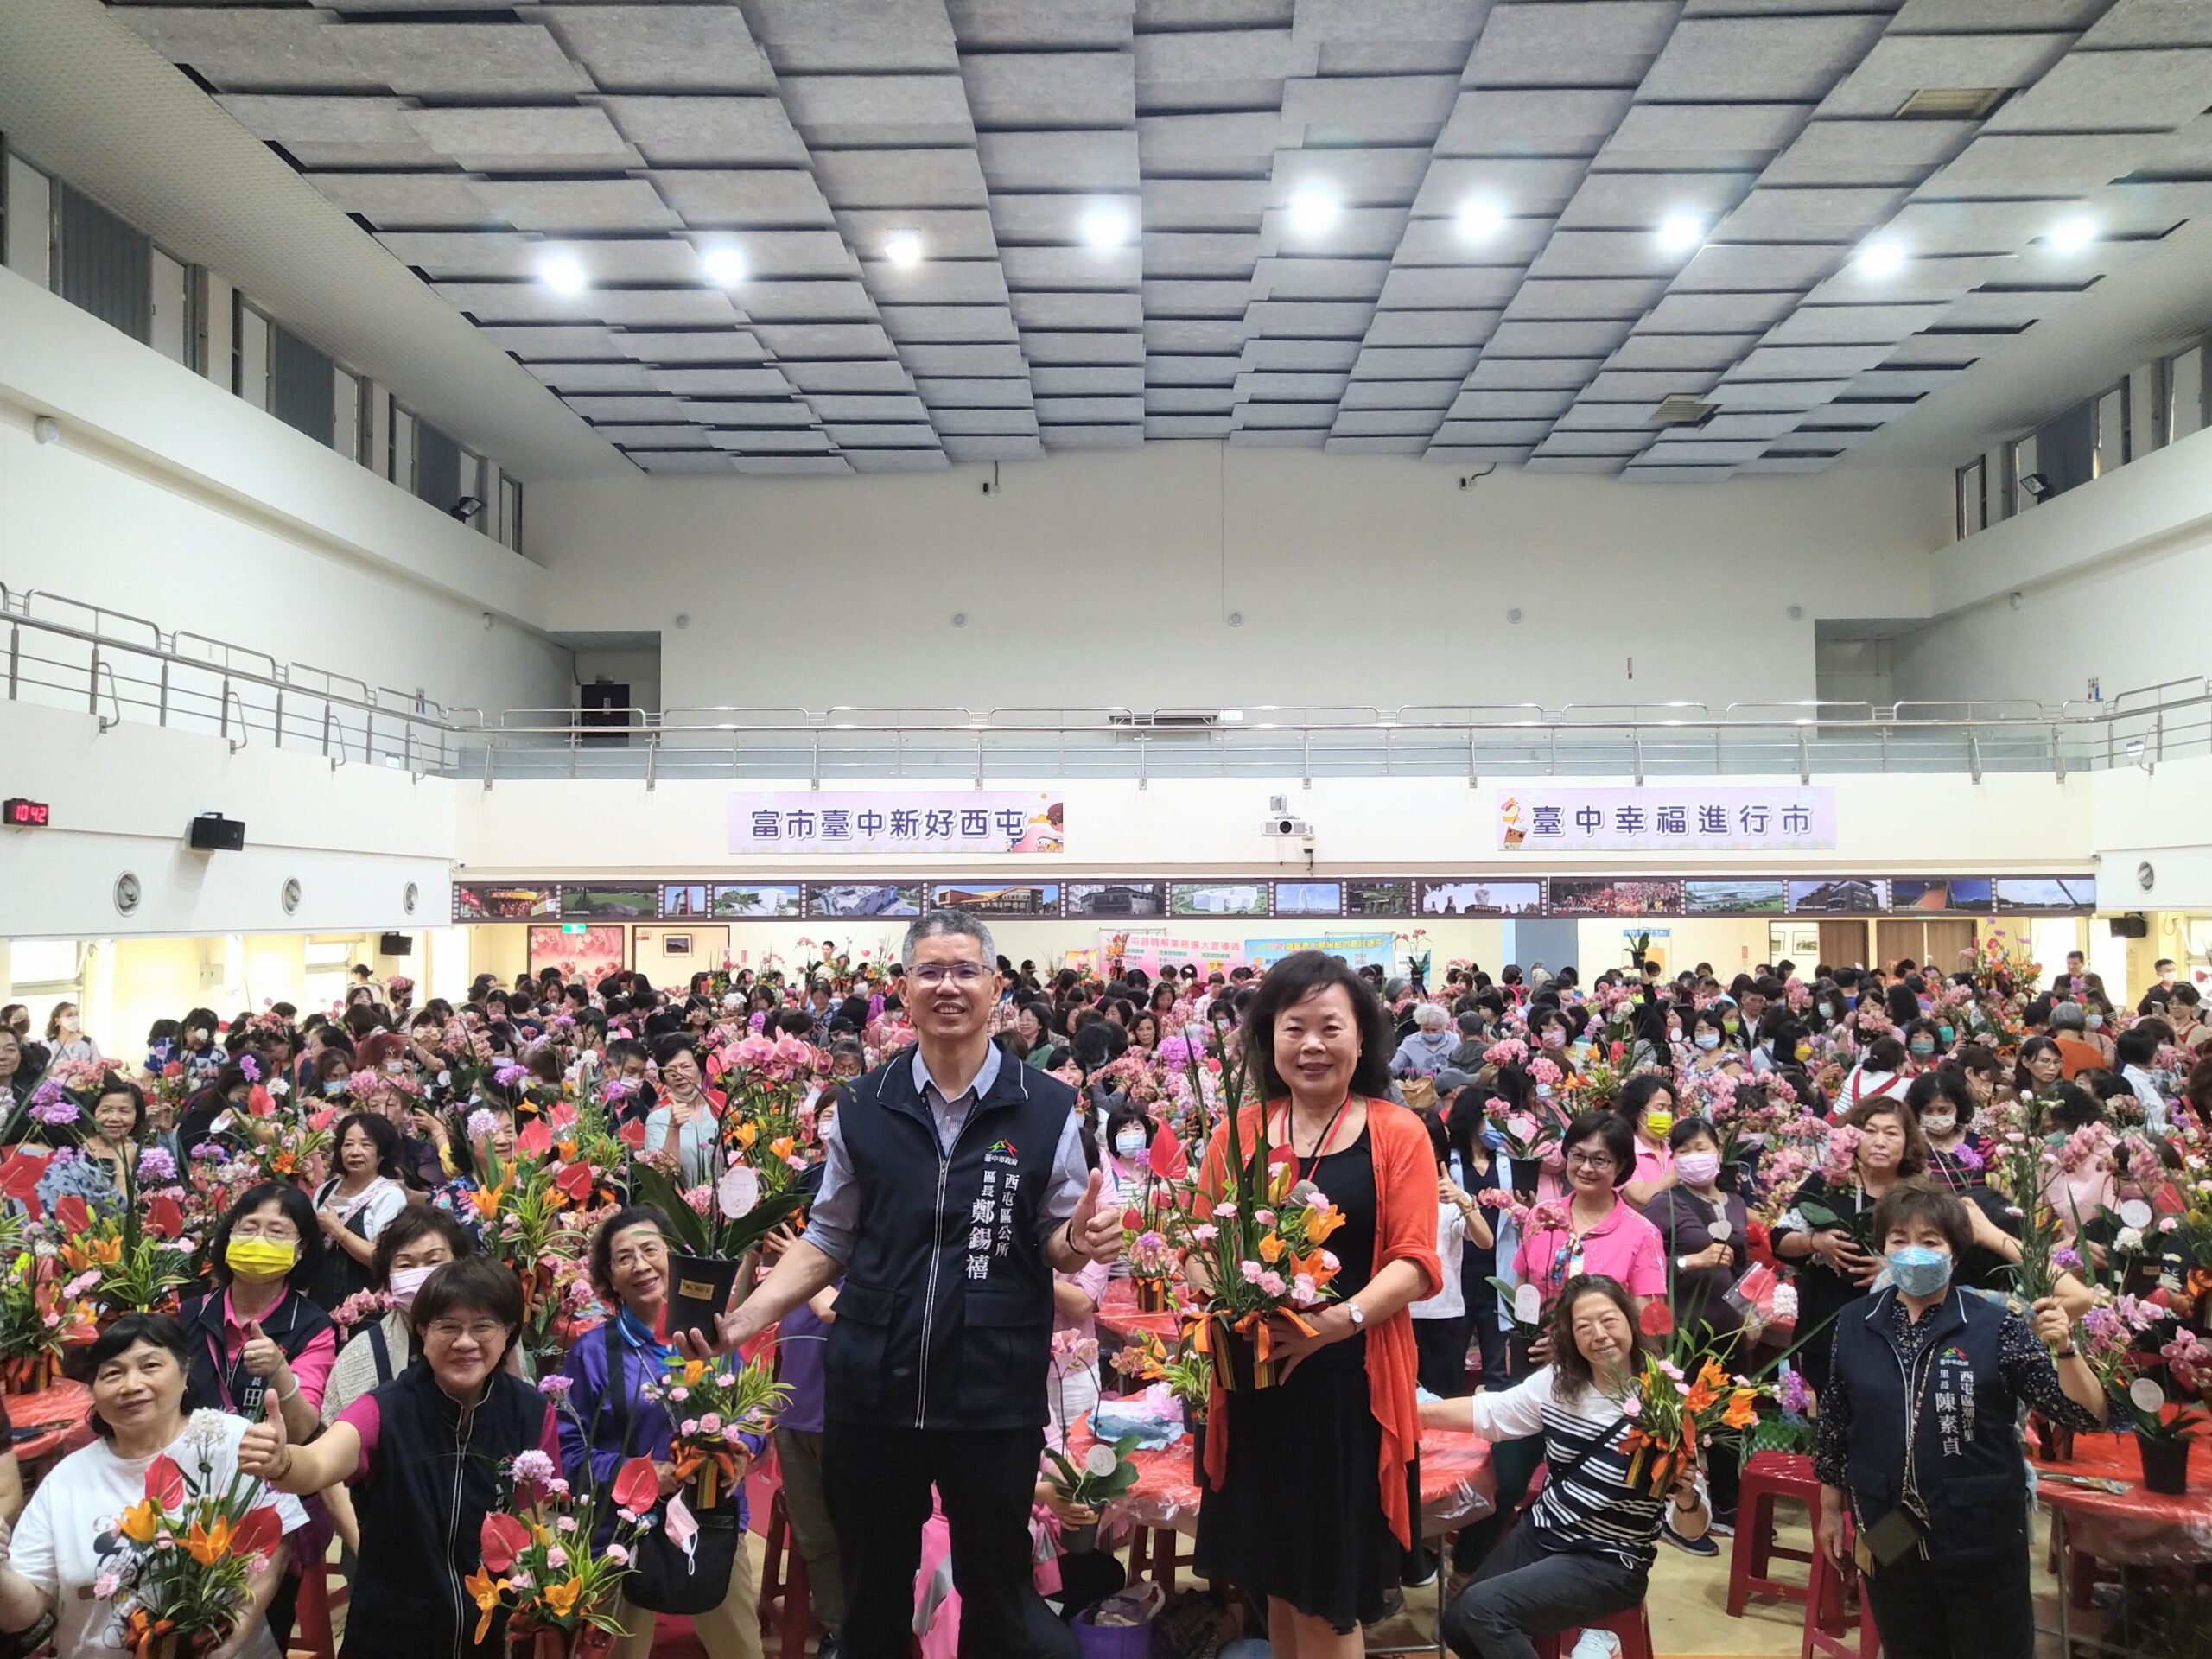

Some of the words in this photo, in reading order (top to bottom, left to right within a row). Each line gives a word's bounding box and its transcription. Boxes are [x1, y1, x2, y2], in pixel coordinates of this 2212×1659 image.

[751, 809, 1027, 838] 富市臺中新好西屯
[1532, 804, 1810, 835] 臺中幸福進行市
[995, 1173, 1020, 1258] 西屯區公所
